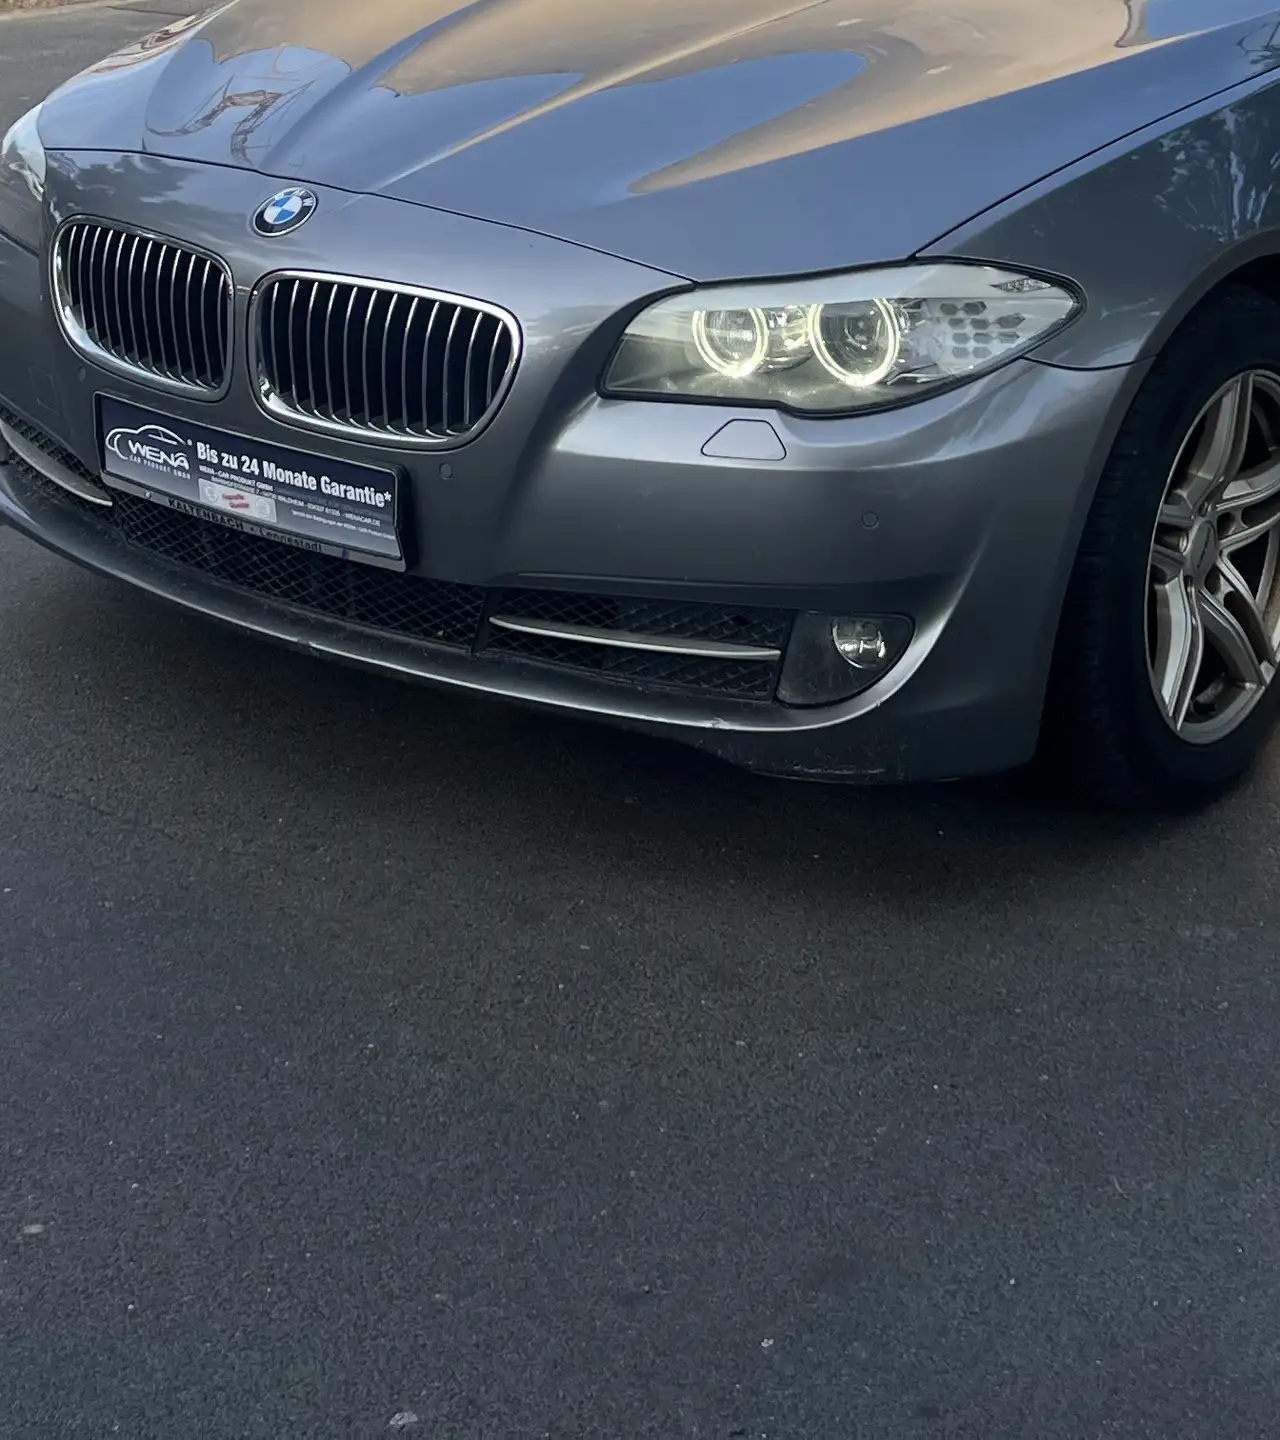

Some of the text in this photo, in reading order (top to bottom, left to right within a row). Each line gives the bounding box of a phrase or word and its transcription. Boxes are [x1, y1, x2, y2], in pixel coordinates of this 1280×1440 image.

[196, 441, 219, 464] Bis
[221, 452, 238, 470] zu
[240, 455, 259, 475] 24
[263, 460, 317, 491] Monate
[168, 498, 245, 531] KALTENBACH
